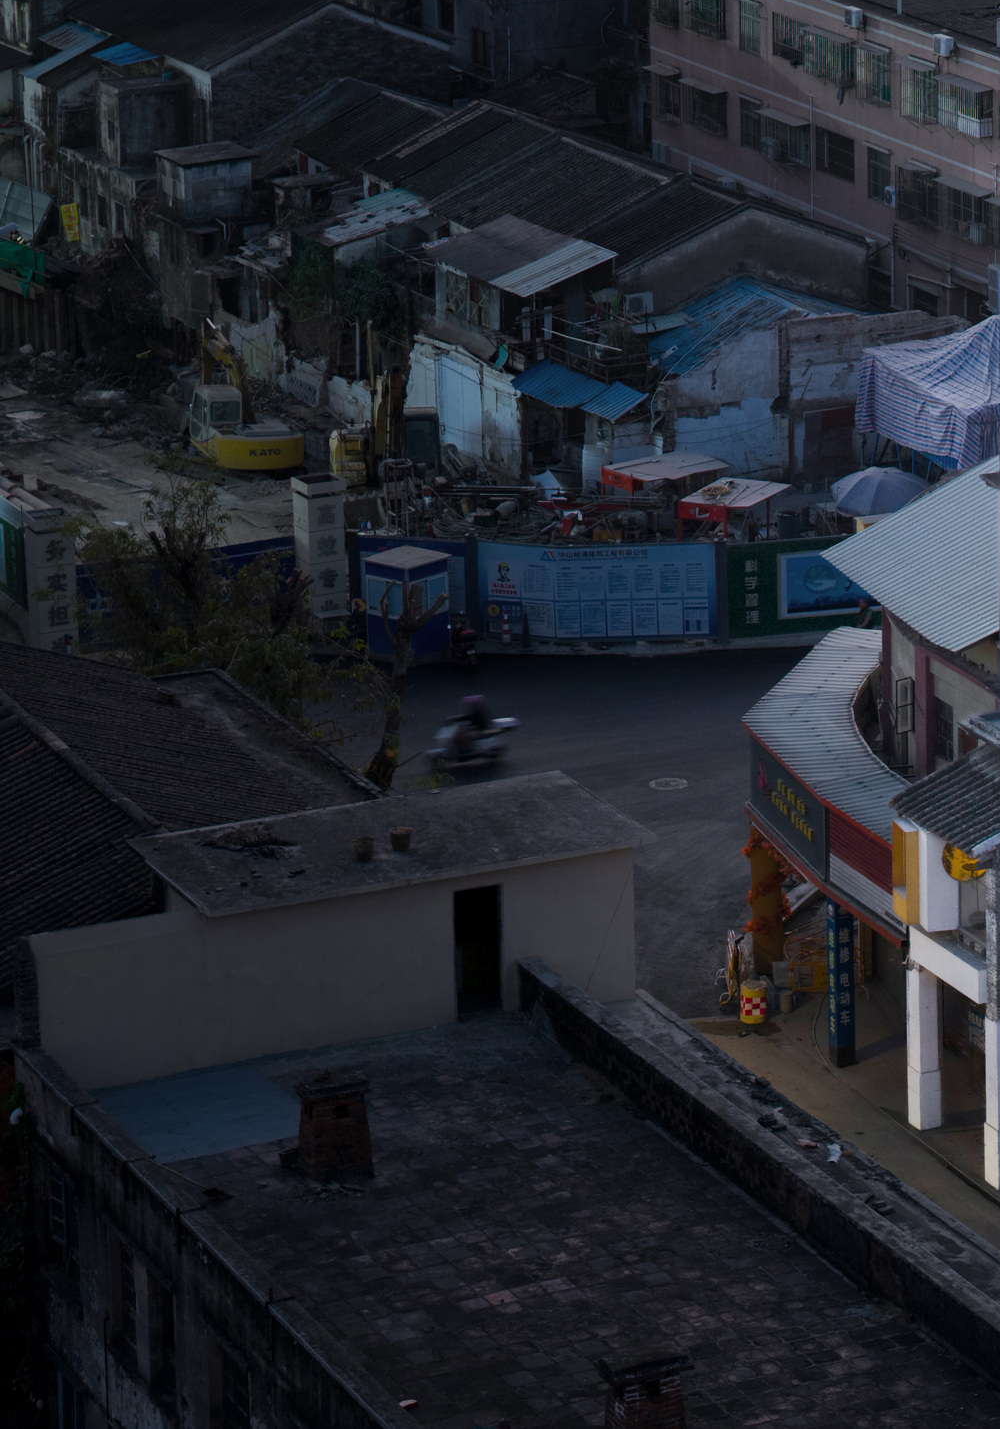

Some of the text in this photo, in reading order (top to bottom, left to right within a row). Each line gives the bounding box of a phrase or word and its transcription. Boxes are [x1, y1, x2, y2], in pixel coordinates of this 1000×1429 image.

[249, 448, 281, 456] KATO
[744, 559, 760, 624] 科学管理
[838, 927, 851, 1026] 维修电动车
